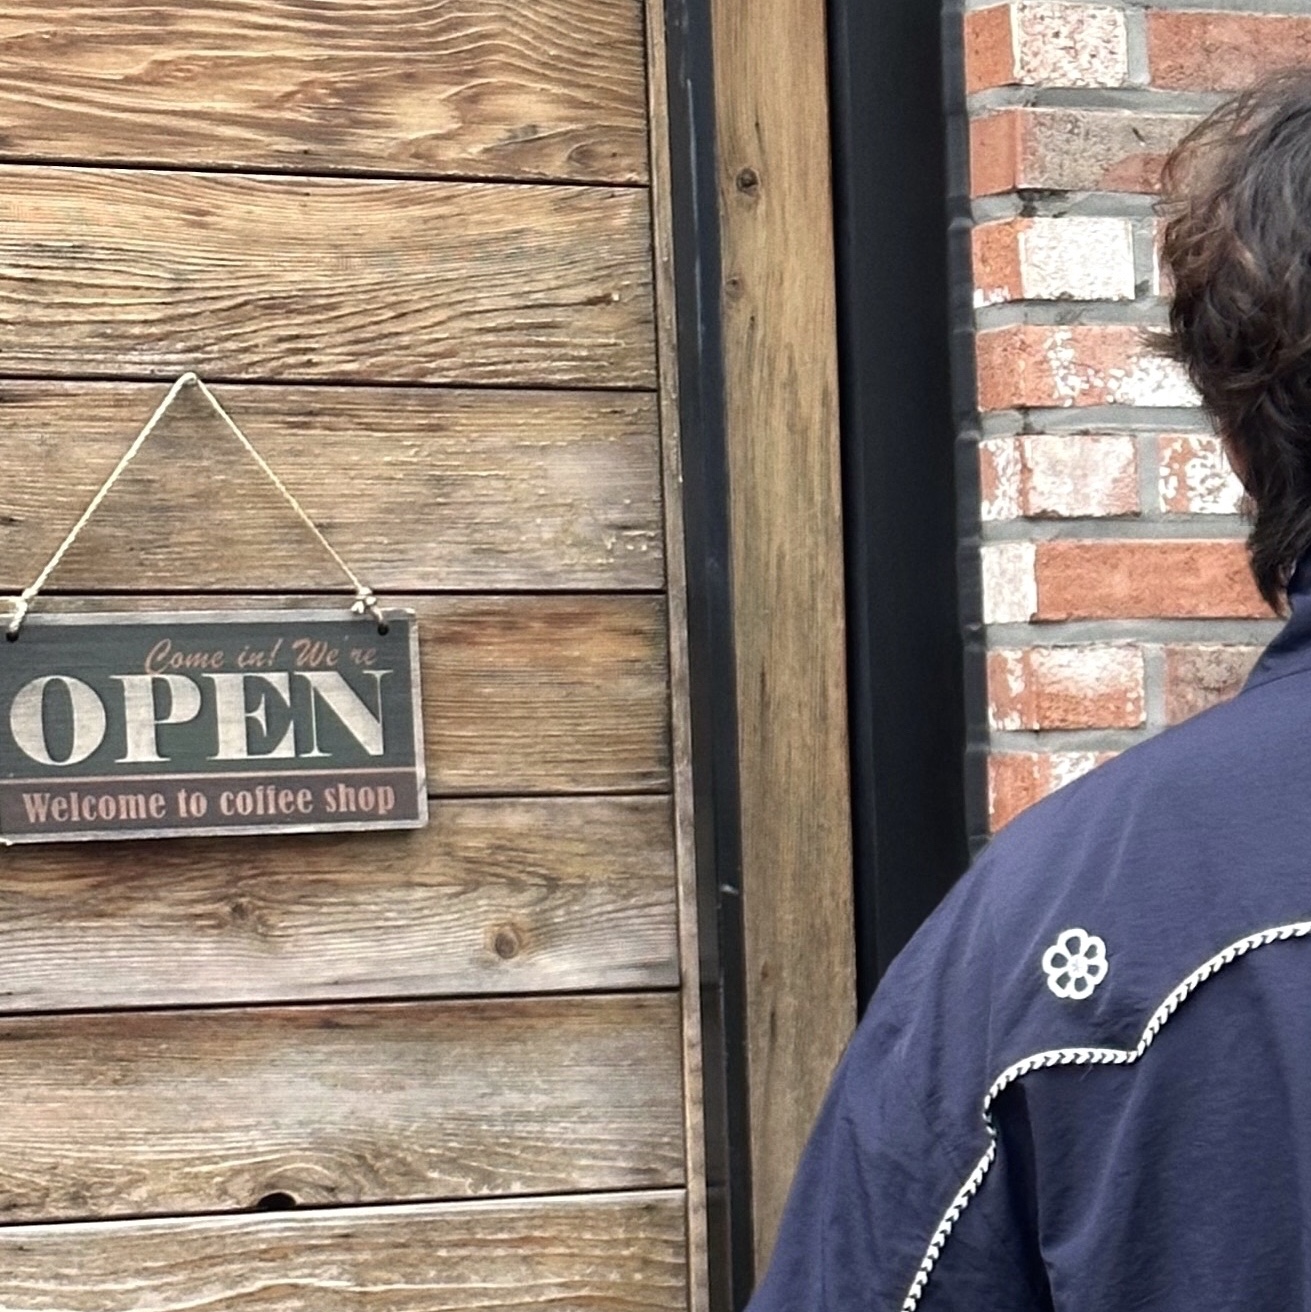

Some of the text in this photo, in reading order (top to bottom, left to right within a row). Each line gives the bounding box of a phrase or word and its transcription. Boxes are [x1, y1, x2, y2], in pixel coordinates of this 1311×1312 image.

[145, 638, 224, 674] Come
[237, 638, 283, 666] in!
[9, 670, 393, 766] OPEN
[22, 783, 396, 823] Welcome to coffee shop
